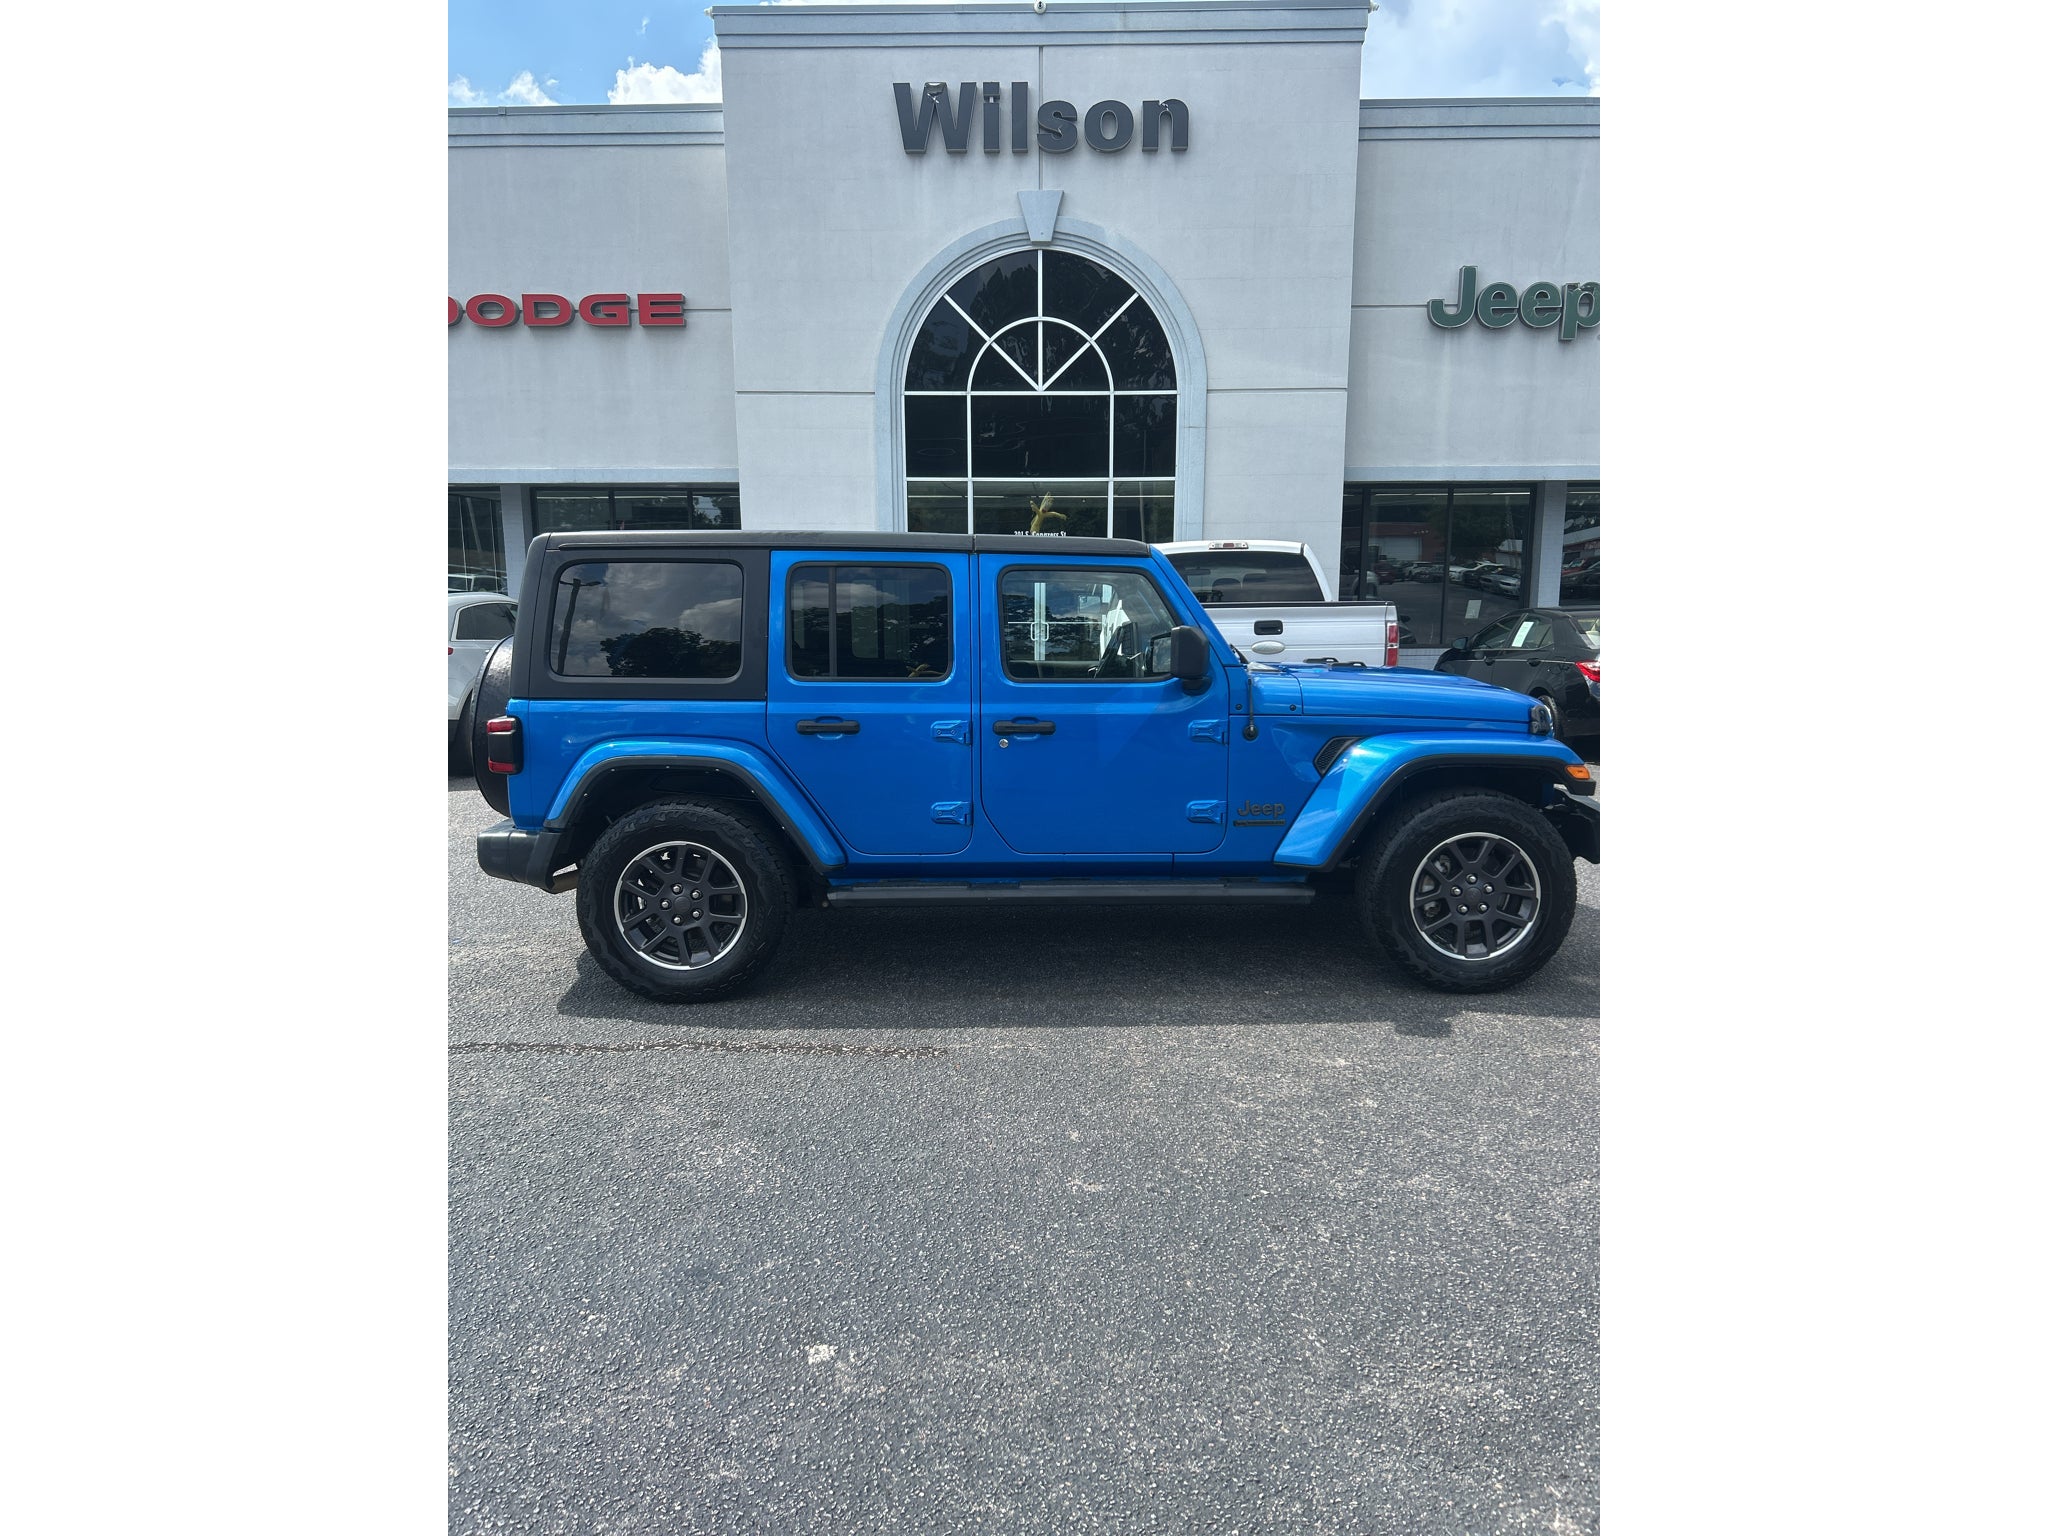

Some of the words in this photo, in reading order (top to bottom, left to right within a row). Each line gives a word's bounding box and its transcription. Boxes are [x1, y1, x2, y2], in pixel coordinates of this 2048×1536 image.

[892, 81, 1189, 154] Wilson
[448, 293, 686, 328] ODGE
[1427, 265, 1600, 341] Jeep
[1237, 799, 1286, 818] Jeep
